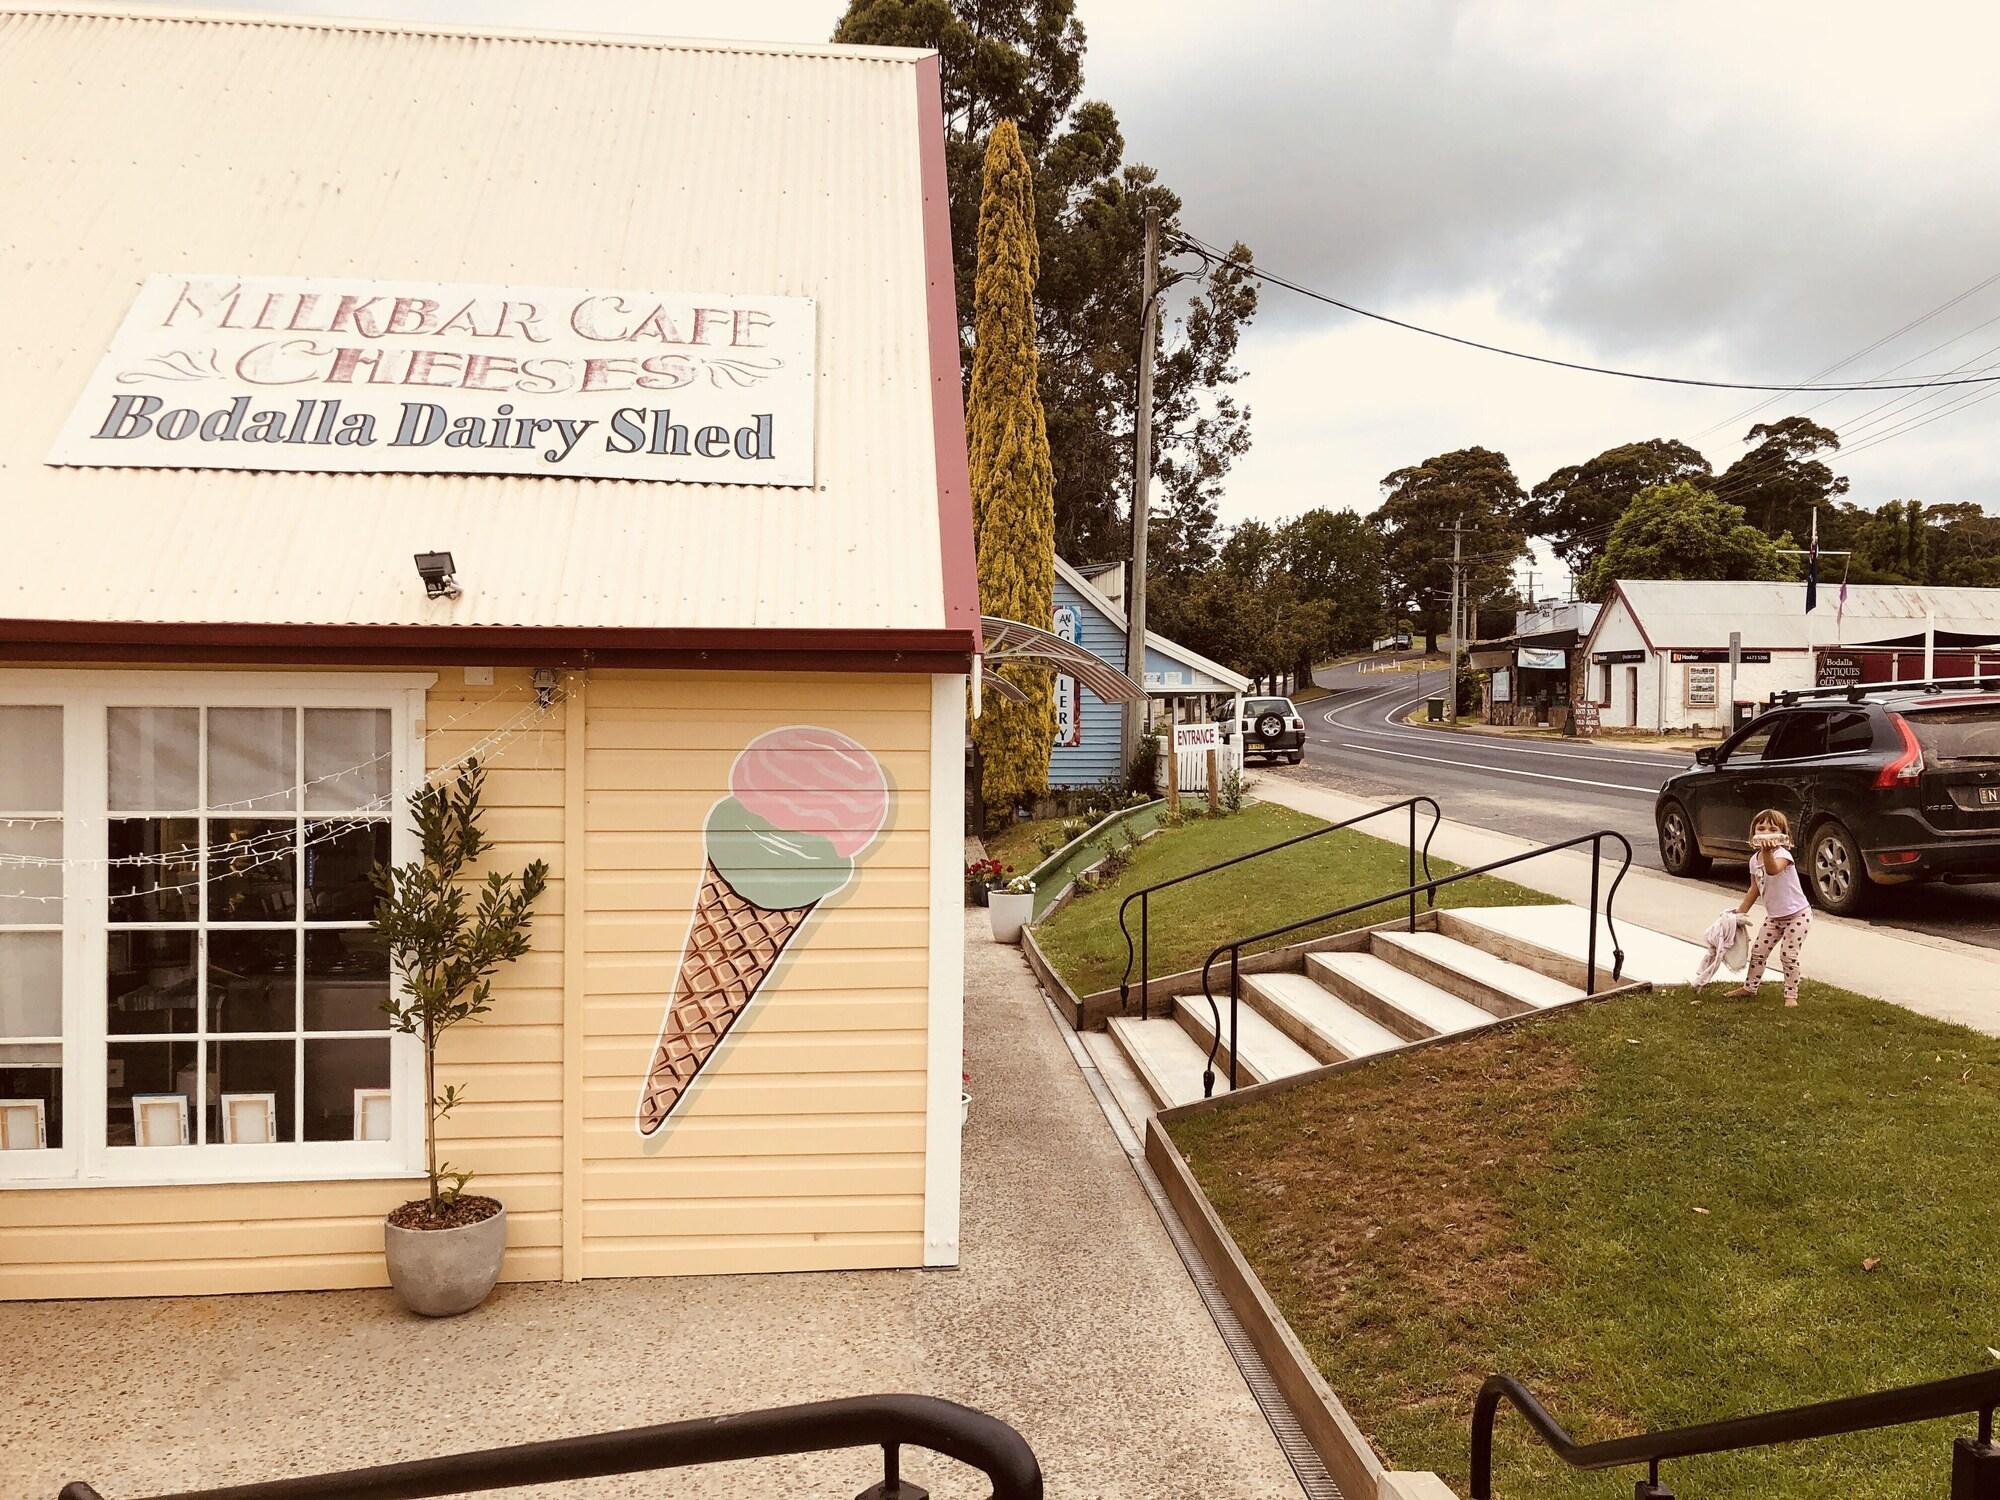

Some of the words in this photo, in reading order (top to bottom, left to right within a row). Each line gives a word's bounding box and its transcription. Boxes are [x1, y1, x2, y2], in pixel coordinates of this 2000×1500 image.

[570, 296, 776, 347] CAFE
[235, 339, 698, 394] CHEESES
[90, 395, 379, 446] Bodalla
[387, 402, 599, 463] Dairy
[606, 407, 775, 460] Shed
[1820, 667, 1860, 676] ANTIQUES
[1827, 658, 1853, 666] Bodalla
[1177, 728, 1215, 746] ENTRANCE
